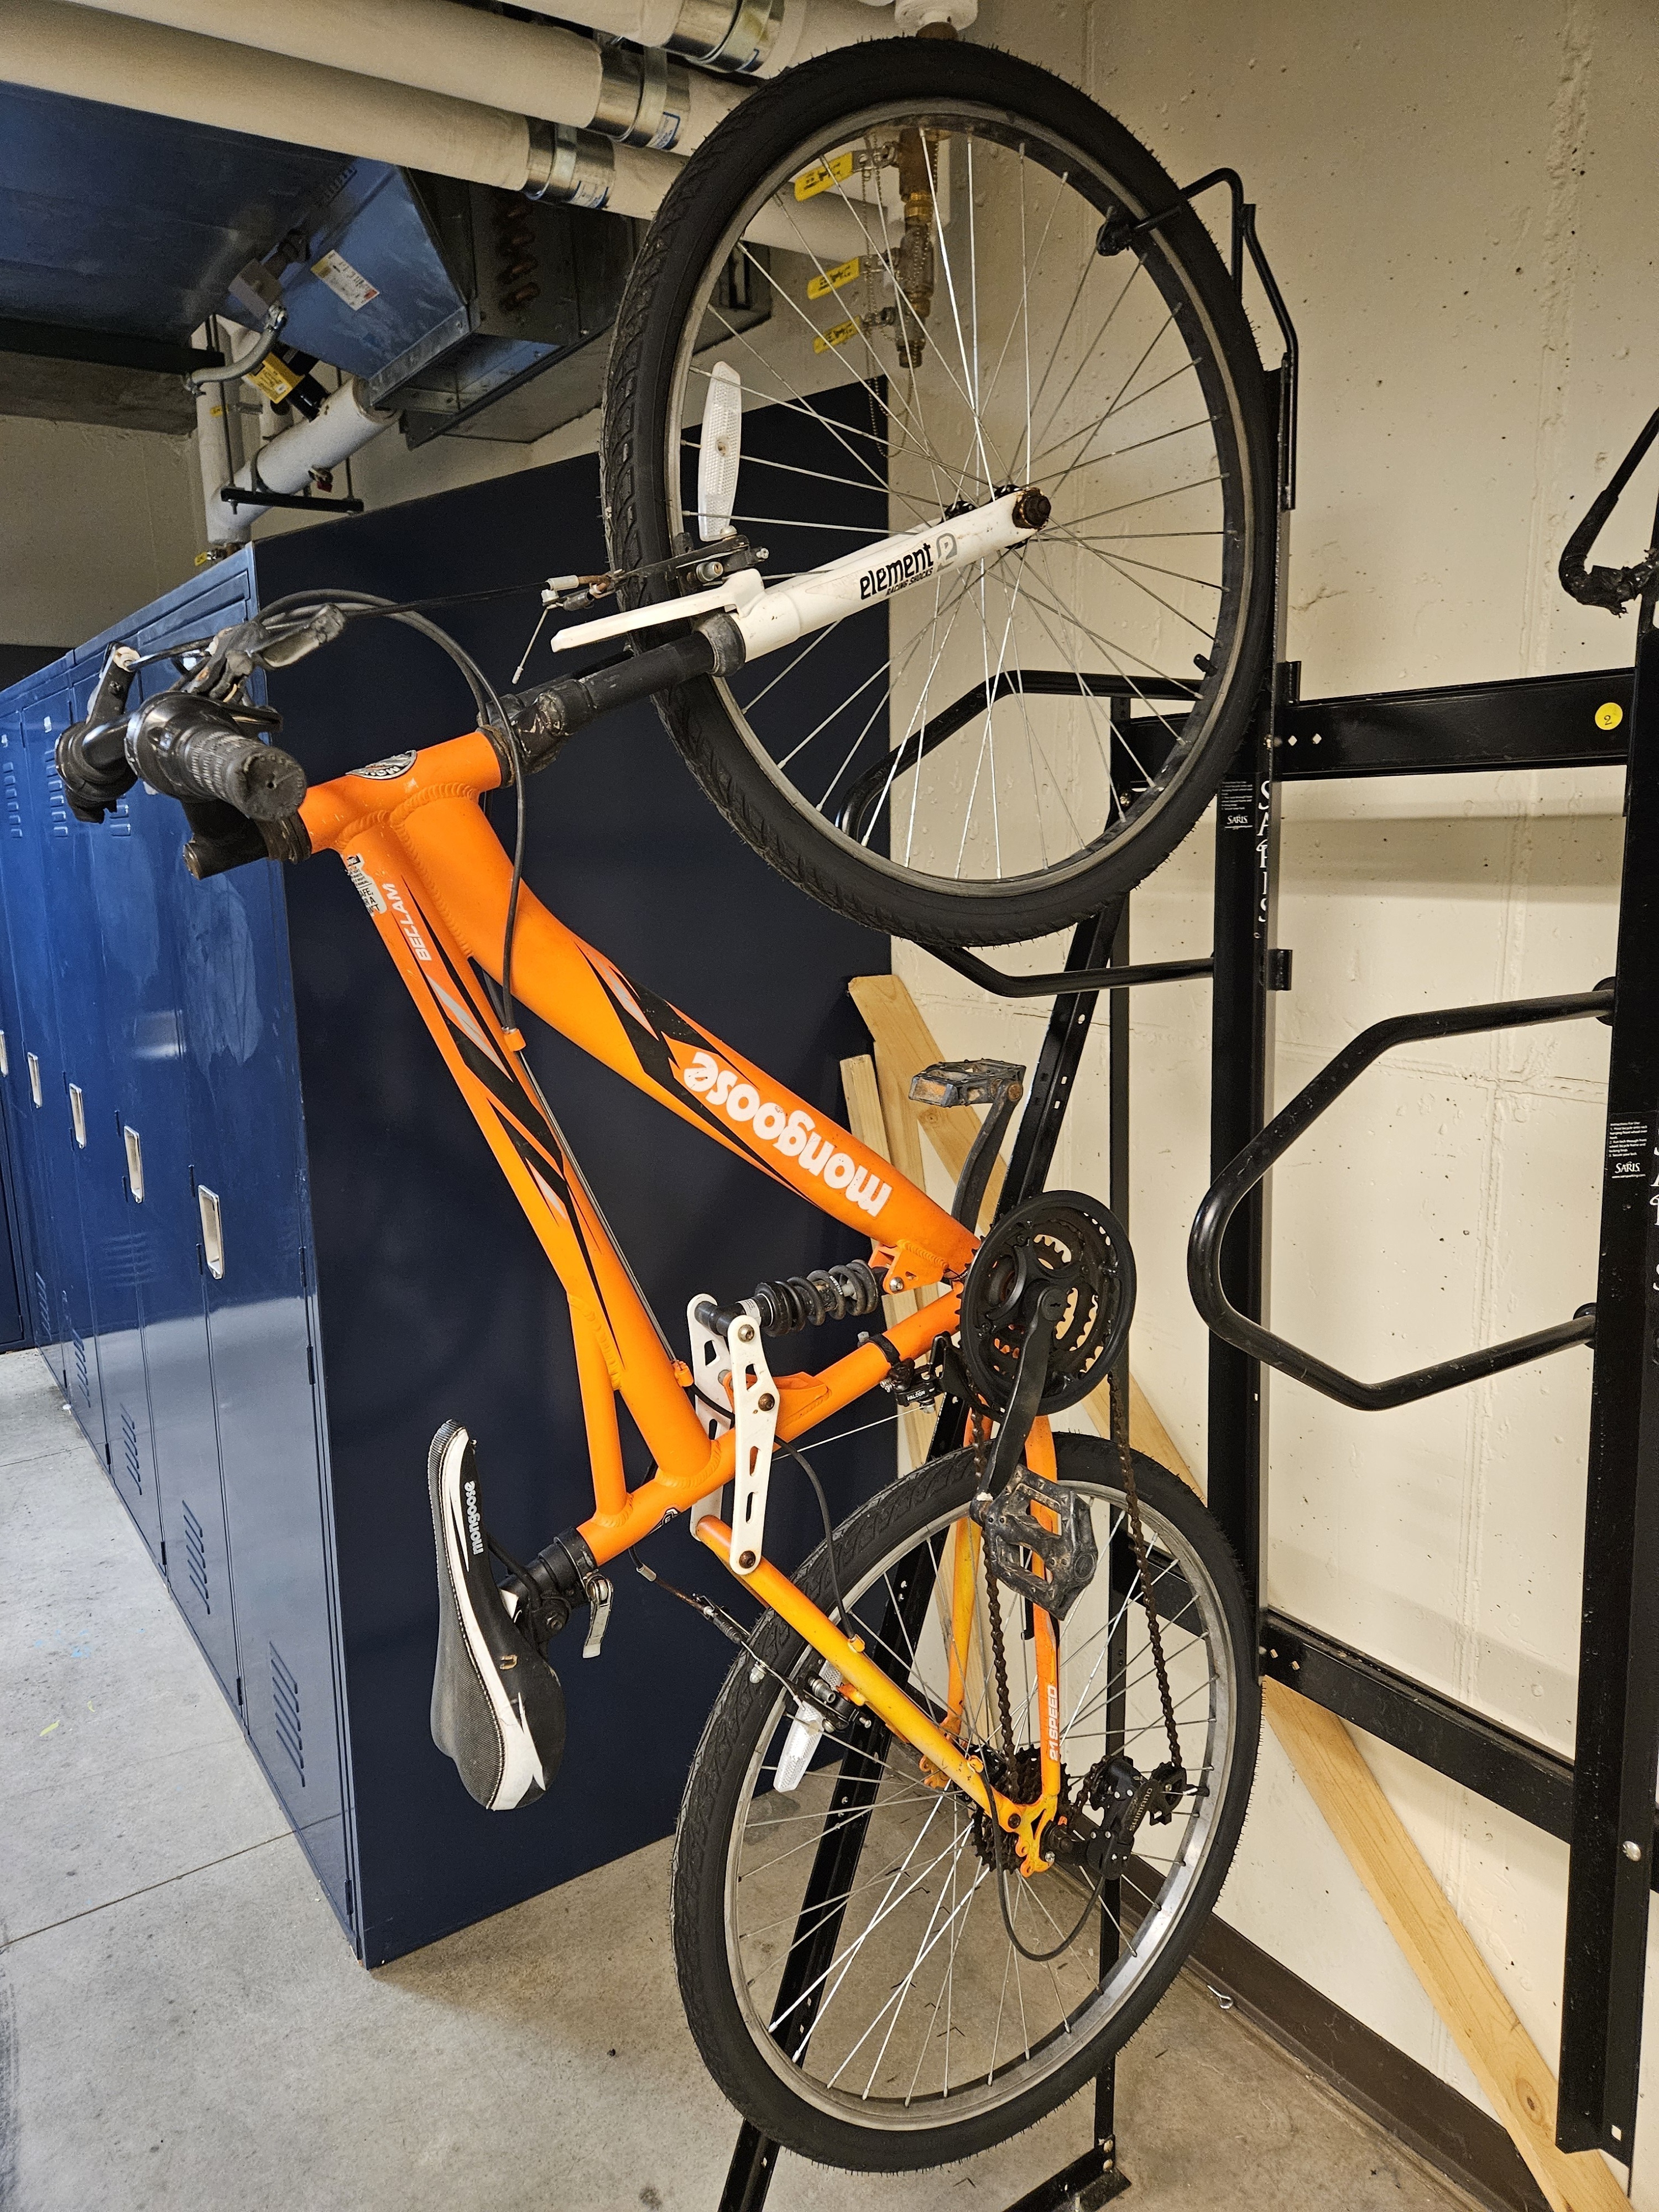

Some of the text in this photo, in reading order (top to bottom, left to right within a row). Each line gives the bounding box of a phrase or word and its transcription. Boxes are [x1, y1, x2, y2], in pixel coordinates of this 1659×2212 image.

[860, 542, 933, 600] element
[886, 567, 933, 597] RACING SHOCKS
[1604, 715, 1612, 725] 2
[1227, 815, 1248, 825] SARIS
[684, 1051, 893, 1217] mongoose
[1615, 1161, 1640, 1173] SARIS
[907, 1390, 925, 1401] FALCON
[464, 1480, 484, 1554] mongoose
[1047, 1684, 1058, 1761] 21 SPEED
[1129, 1788, 1152, 1831] SHIMANO
